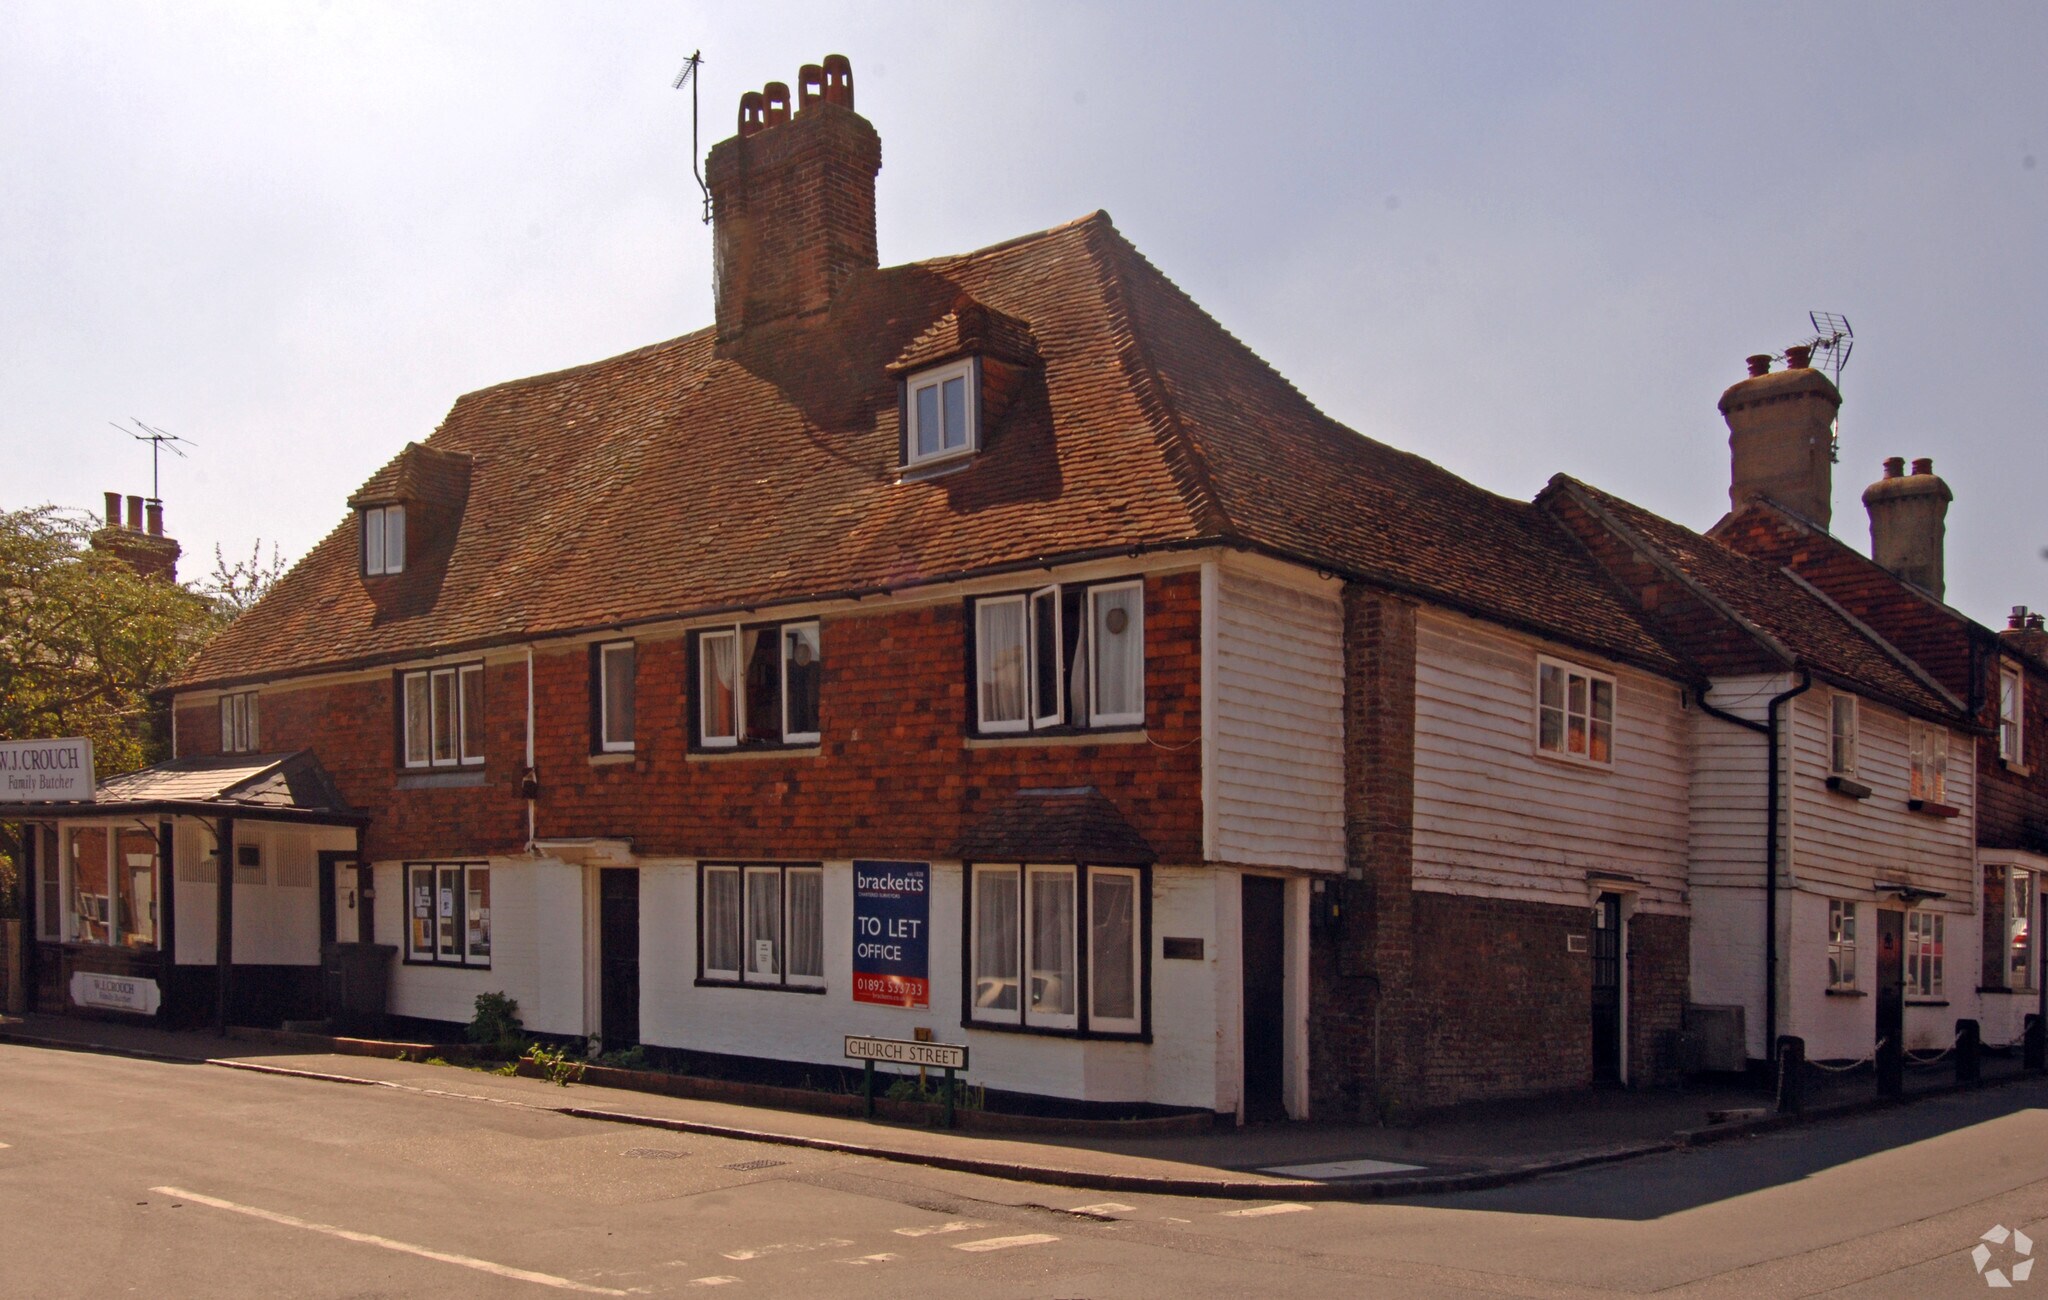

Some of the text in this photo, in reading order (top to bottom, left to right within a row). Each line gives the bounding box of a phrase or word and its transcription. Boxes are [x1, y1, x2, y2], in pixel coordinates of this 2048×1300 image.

[8, 774, 74, 793] Family Butcher
[858, 872, 924, 892] bracketts
[858, 917, 921, 938] TO LET
[858, 943, 901, 960] OFFICE
[857, 978, 922, 996] 01892 533733
[849, 1041, 958, 1064] CHURCH STREET
